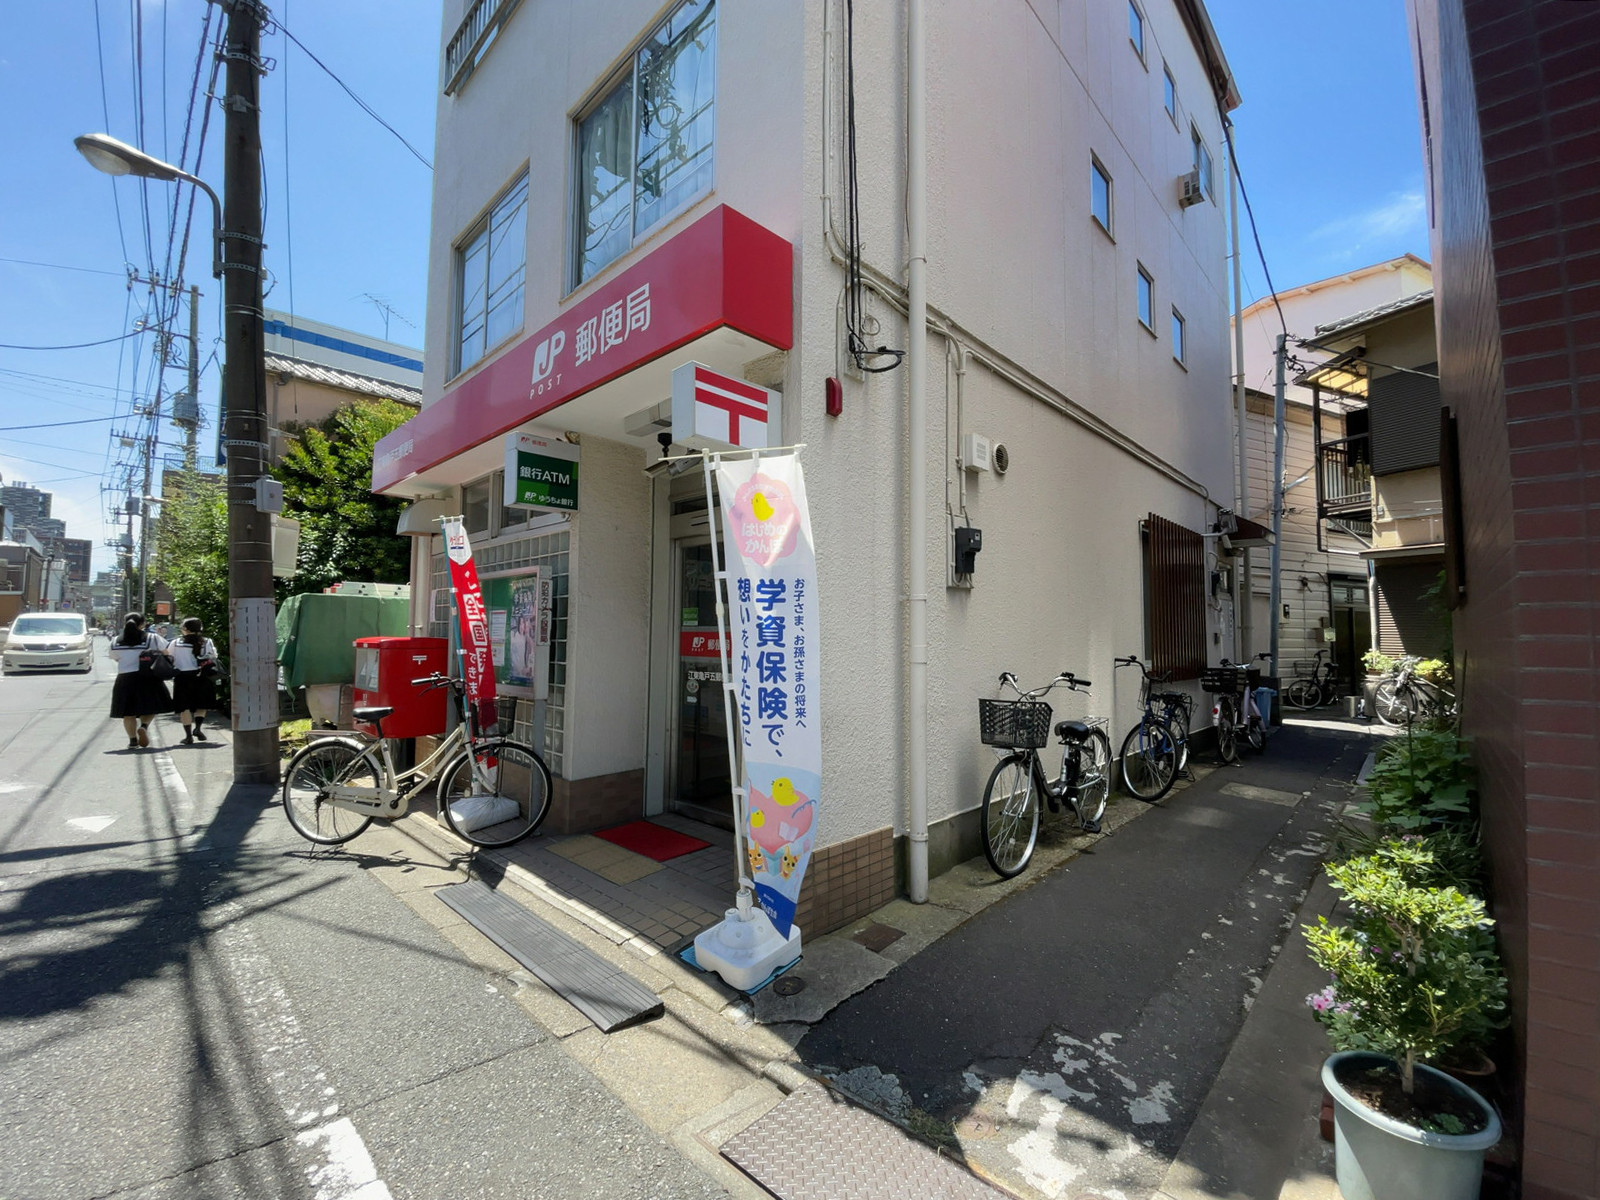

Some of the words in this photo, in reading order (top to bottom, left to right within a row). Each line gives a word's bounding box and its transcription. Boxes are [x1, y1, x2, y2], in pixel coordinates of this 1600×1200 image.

[575, 282, 650, 367] 郵便局
[530, 373, 562, 399] POST
[520, 465, 570, 485] 銀行ATM
[538, 495, 574, 507] ゆうちょ銀行
[741, 521, 788, 537] はじめの
[737, 577, 751, 747] 想いをかたちに
[793, 578, 807, 728] お子さま、お孫さまの将来へ
[688, 670, 726, 682] 江東亀戸五郵
[755, 578, 788, 758] 学資保険で、
